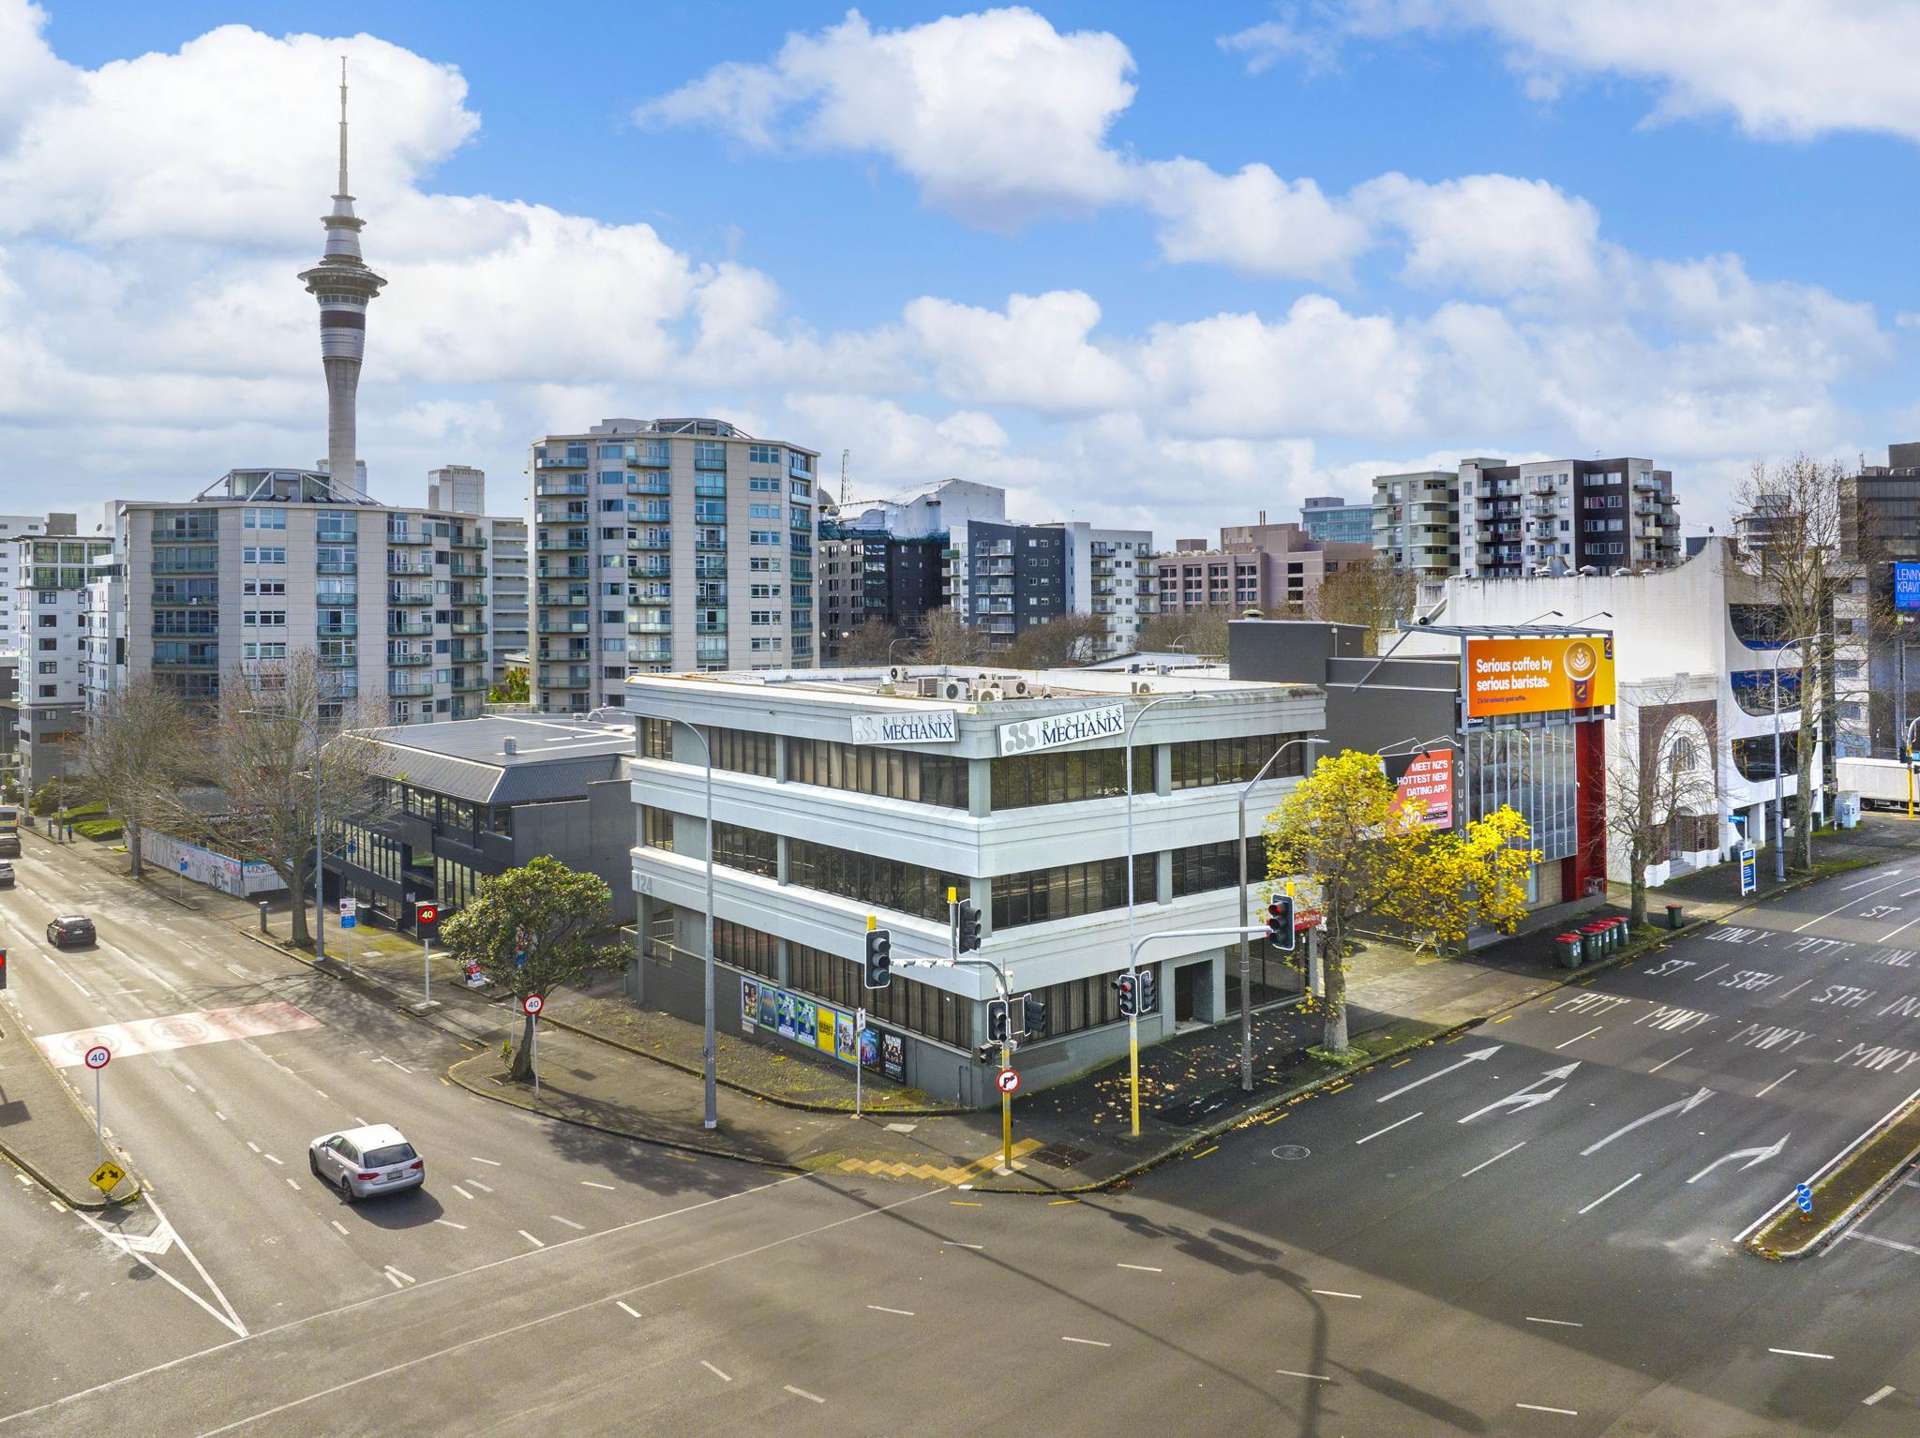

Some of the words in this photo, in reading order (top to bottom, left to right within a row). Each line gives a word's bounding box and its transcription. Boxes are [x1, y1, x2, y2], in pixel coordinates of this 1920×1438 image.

[1476, 658, 1511, 673] Serious
[1512, 657, 1541, 671] coffee
[1541, 656, 1553, 673] by
[1476, 676, 1510, 691] serious
[1511, 674, 1550, 690] baristas.
[881, 714, 952, 725] BUSINESS
[1042, 707, 1121, 729] BUSINESS
[882, 722, 953, 741] MECHANIX
[1041, 716, 1123, 745] MECHANIX
[1411, 761, 1431, 771] MEET
[1396, 774, 1430, 785] HOTTEST
[1432, 773, 1448, 782] NEW
[1406, 786, 1432, 796] DATING
[636, 872, 654, 893] 124
[421, 910, 433, 919] 40
[1859, 905, 1902, 919] ST
[1705, 927, 1776, 944] ONLY
[1784, 937, 1856, 956] PITT
[1644, 959, 1697, 976] ST
[1811, 984, 1877, 1007] STH
[527, 1000, 540, 1009] 40
[1554, 992, 1632, 1017] PITT
[1633, 1006, 1720, 1034] MWY
[1727, 1023, 1816, 1053] MWY
[91, 1052, 106, 1062] 40
[1833, 1042, 1920, 1073] MWY
